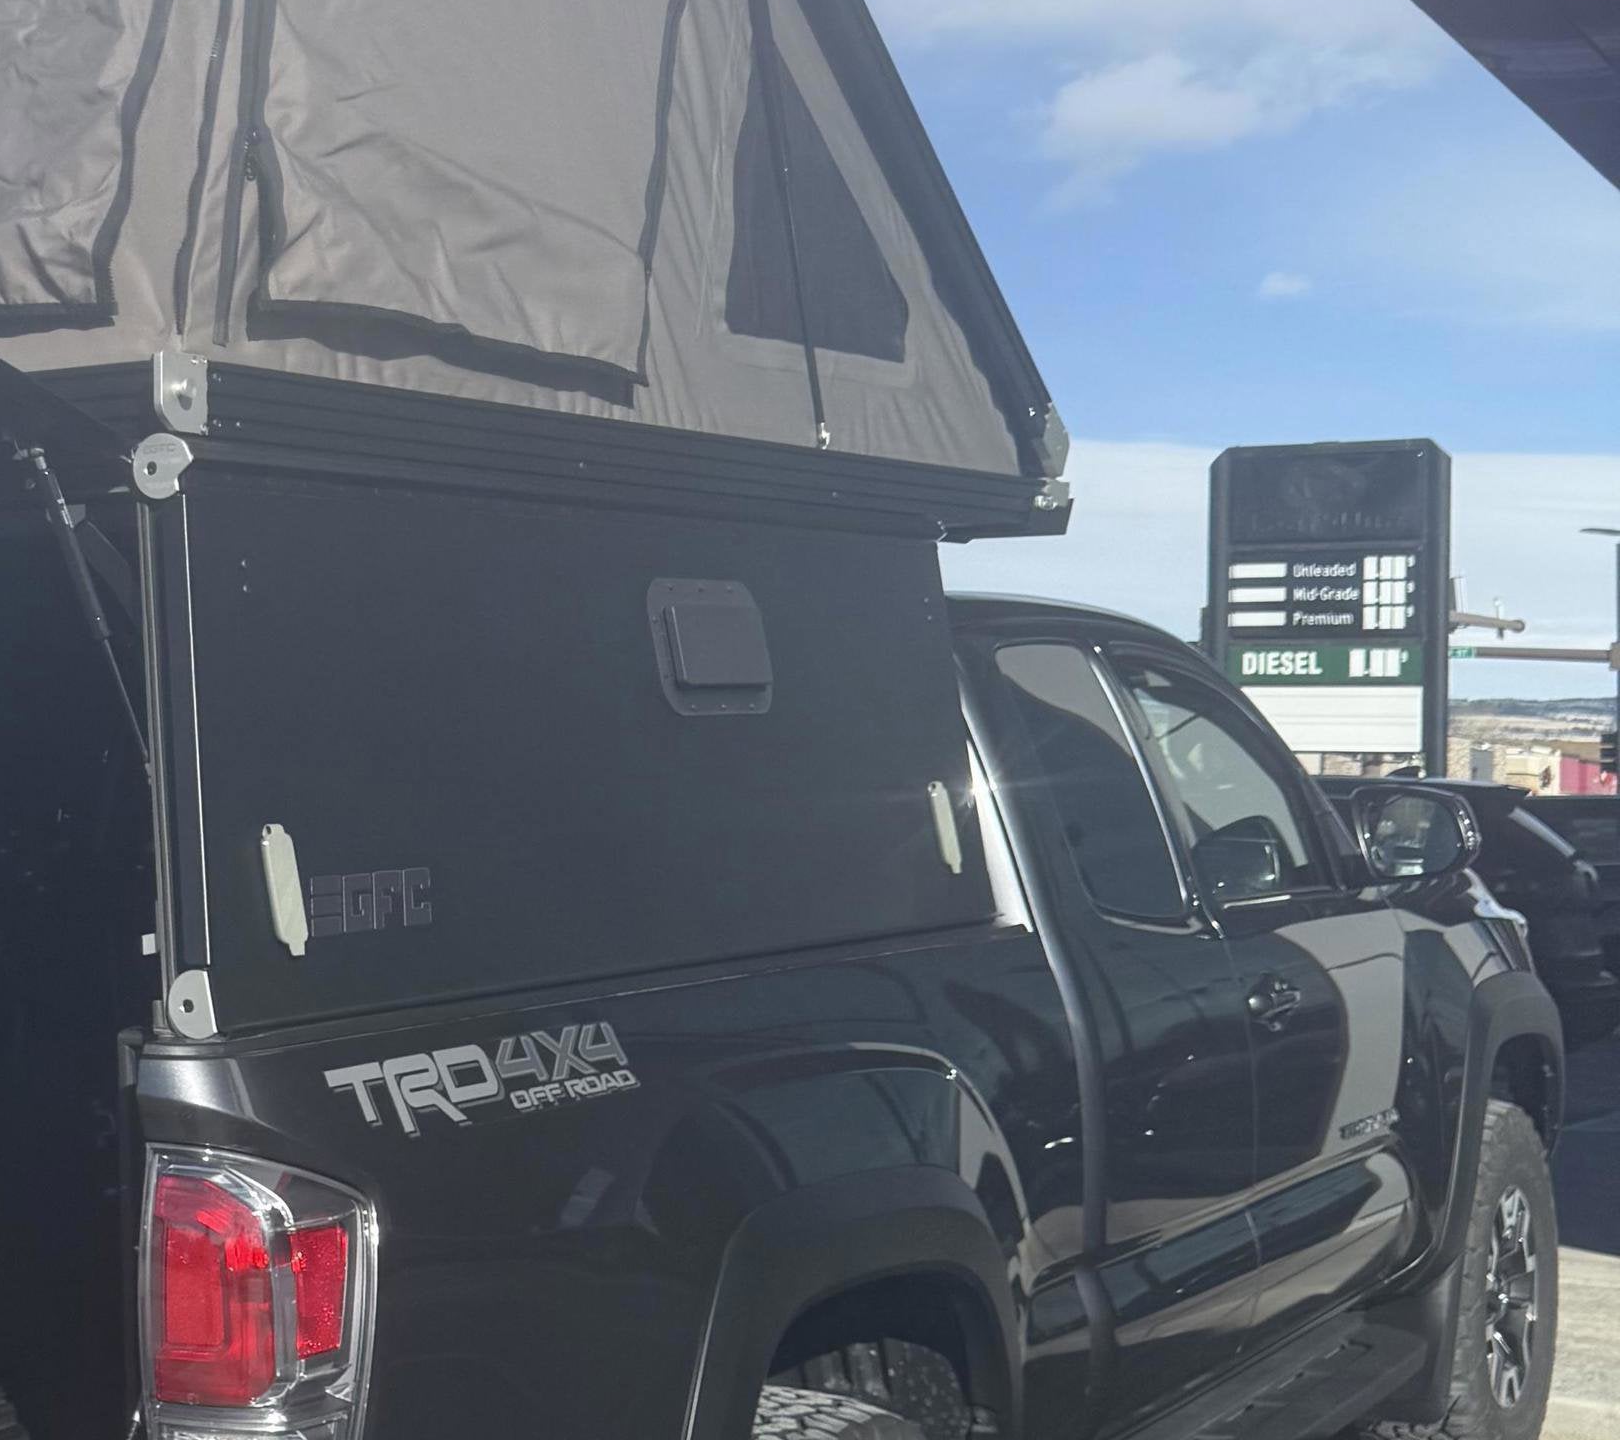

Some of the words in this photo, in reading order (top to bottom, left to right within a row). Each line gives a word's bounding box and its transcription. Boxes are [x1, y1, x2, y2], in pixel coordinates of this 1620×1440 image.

[1292, 563, 1357, 578] Unleaded
[1292, 586, 1359, 601] Mid-Grade
[1292, 611, 1354, 626] Premium
[1241, 651, 1323, 676] DIESEL
[324, 1044, 502, 1137] TRD
[510, 1082, 562, 1112] OFF
[564, 1068, 638, 1101] ROAD
